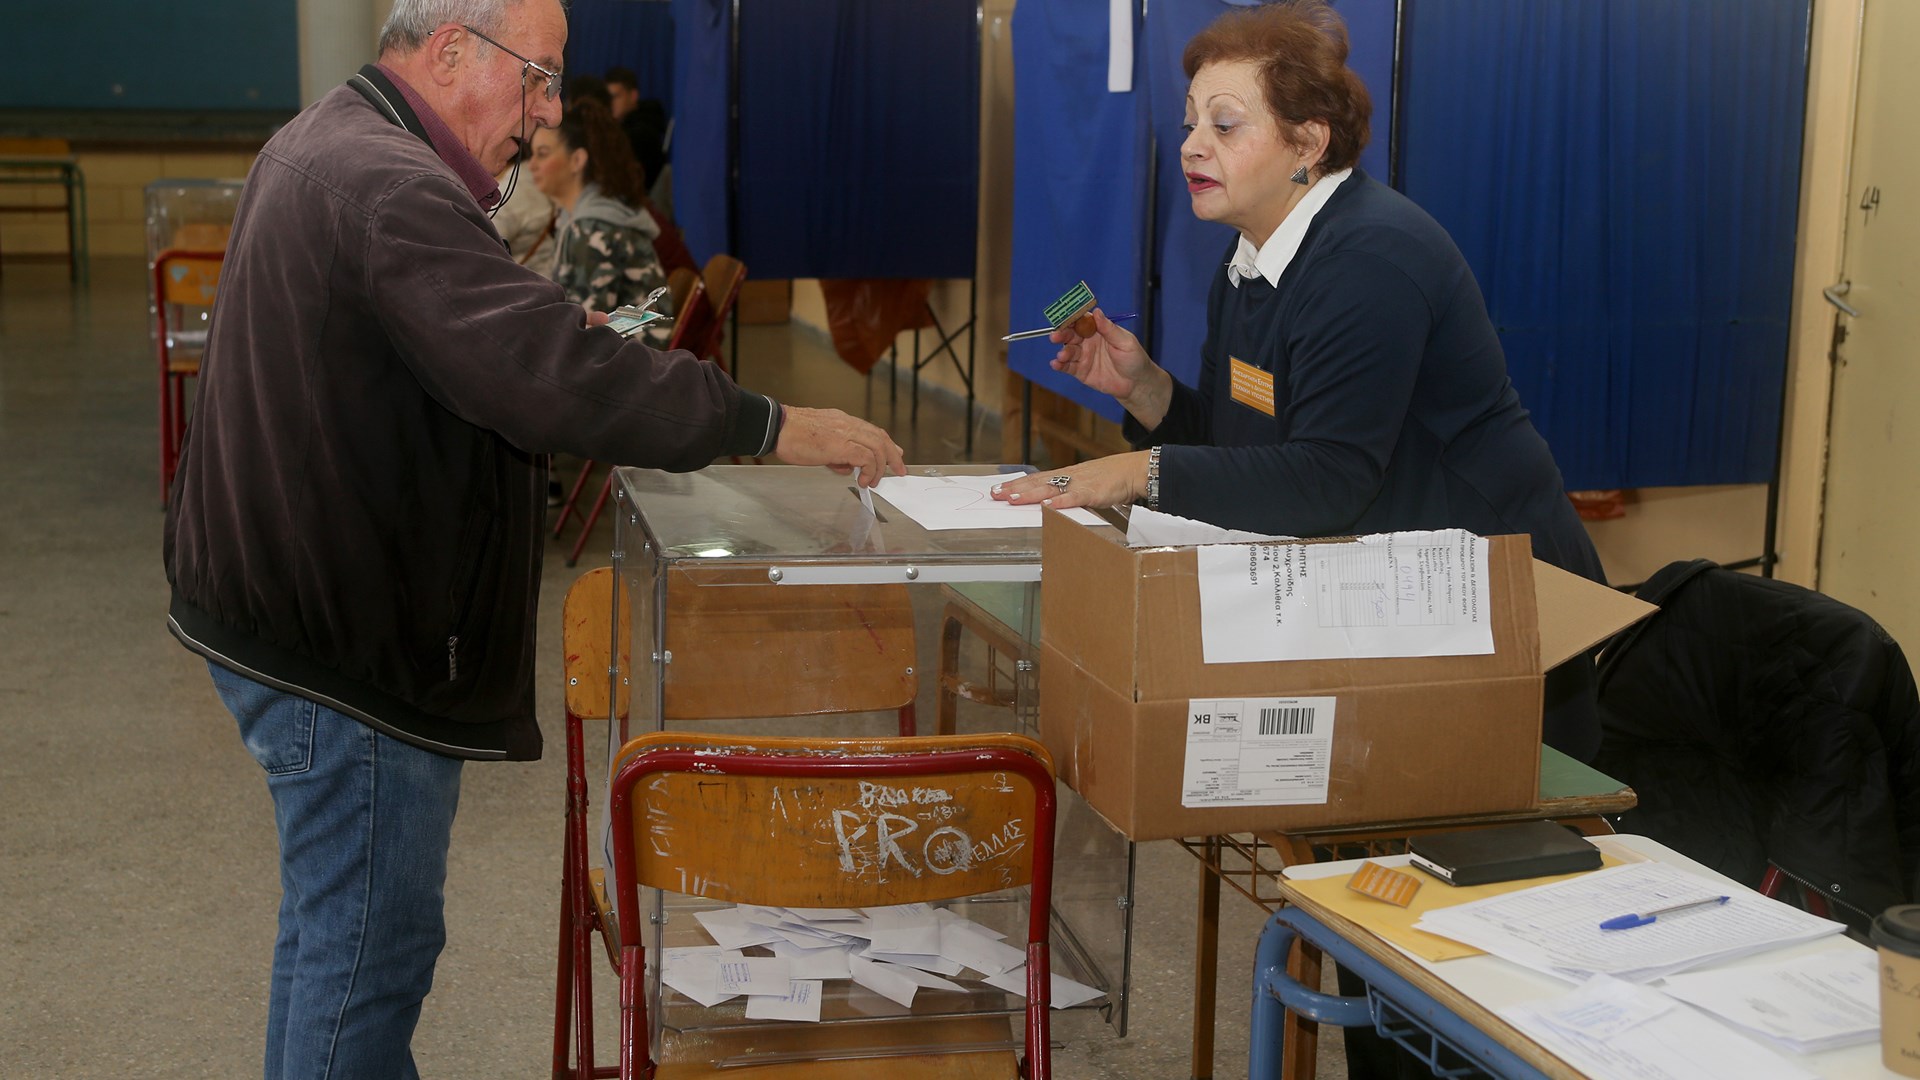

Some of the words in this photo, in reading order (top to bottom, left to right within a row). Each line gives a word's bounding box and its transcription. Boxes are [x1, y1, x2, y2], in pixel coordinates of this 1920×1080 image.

[1860, 186, 1880, 227] 44
[1249, 544, 1258, 586] 08603691
[1194, 714, 1211, 724] BK
